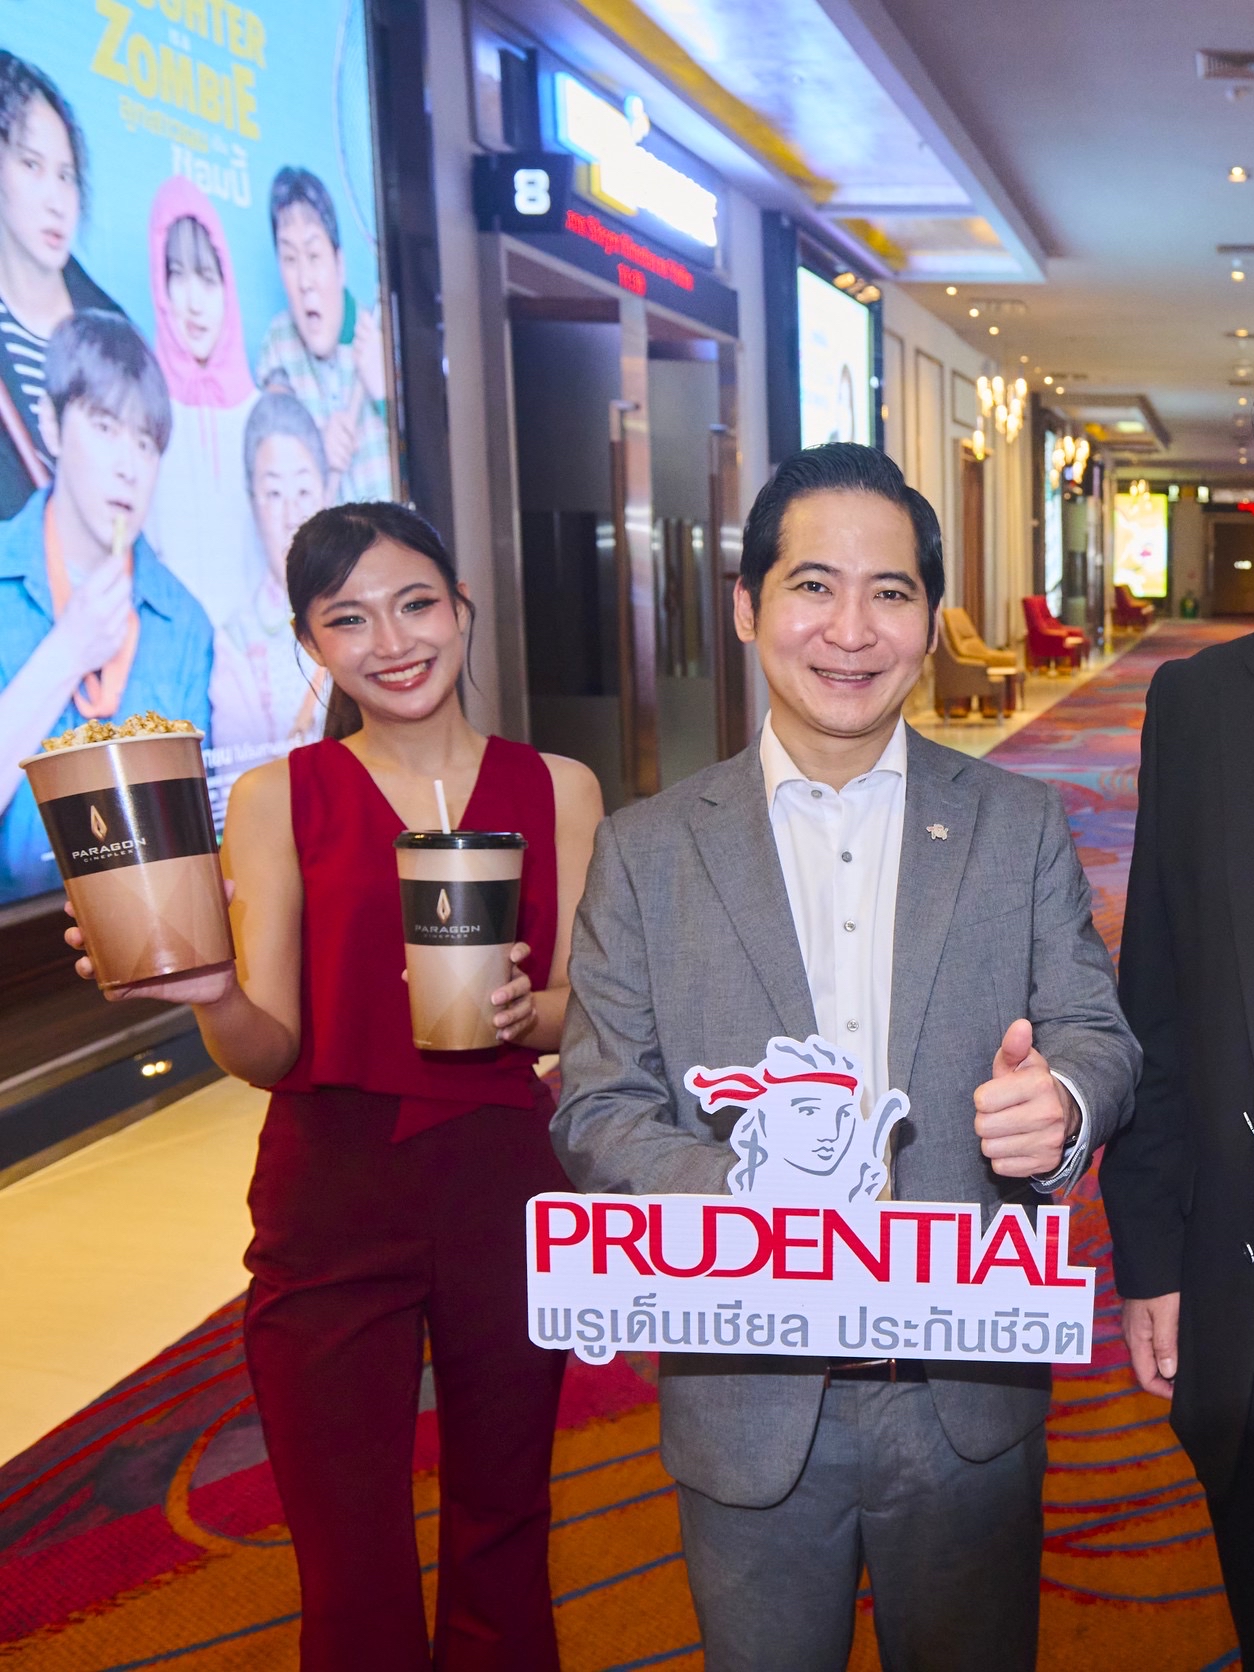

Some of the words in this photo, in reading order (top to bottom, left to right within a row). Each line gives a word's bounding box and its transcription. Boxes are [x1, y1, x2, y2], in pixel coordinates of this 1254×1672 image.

[91, 0, 260, 140] ZOMBIE
[514, 169, 551, 215] 8
[71, 837, 148, 860] PARAGON
[83, 849, 135, 863] CINEPLEX
[414, 924, 481, 934] PARAGON
[534, 1200, 1087, 1288] PRUDENTIAL
[536, 1292, 810, 1358] พรูเด็นเชียล
[837, 1305, 1086, 1356] ประกันชีวิต
